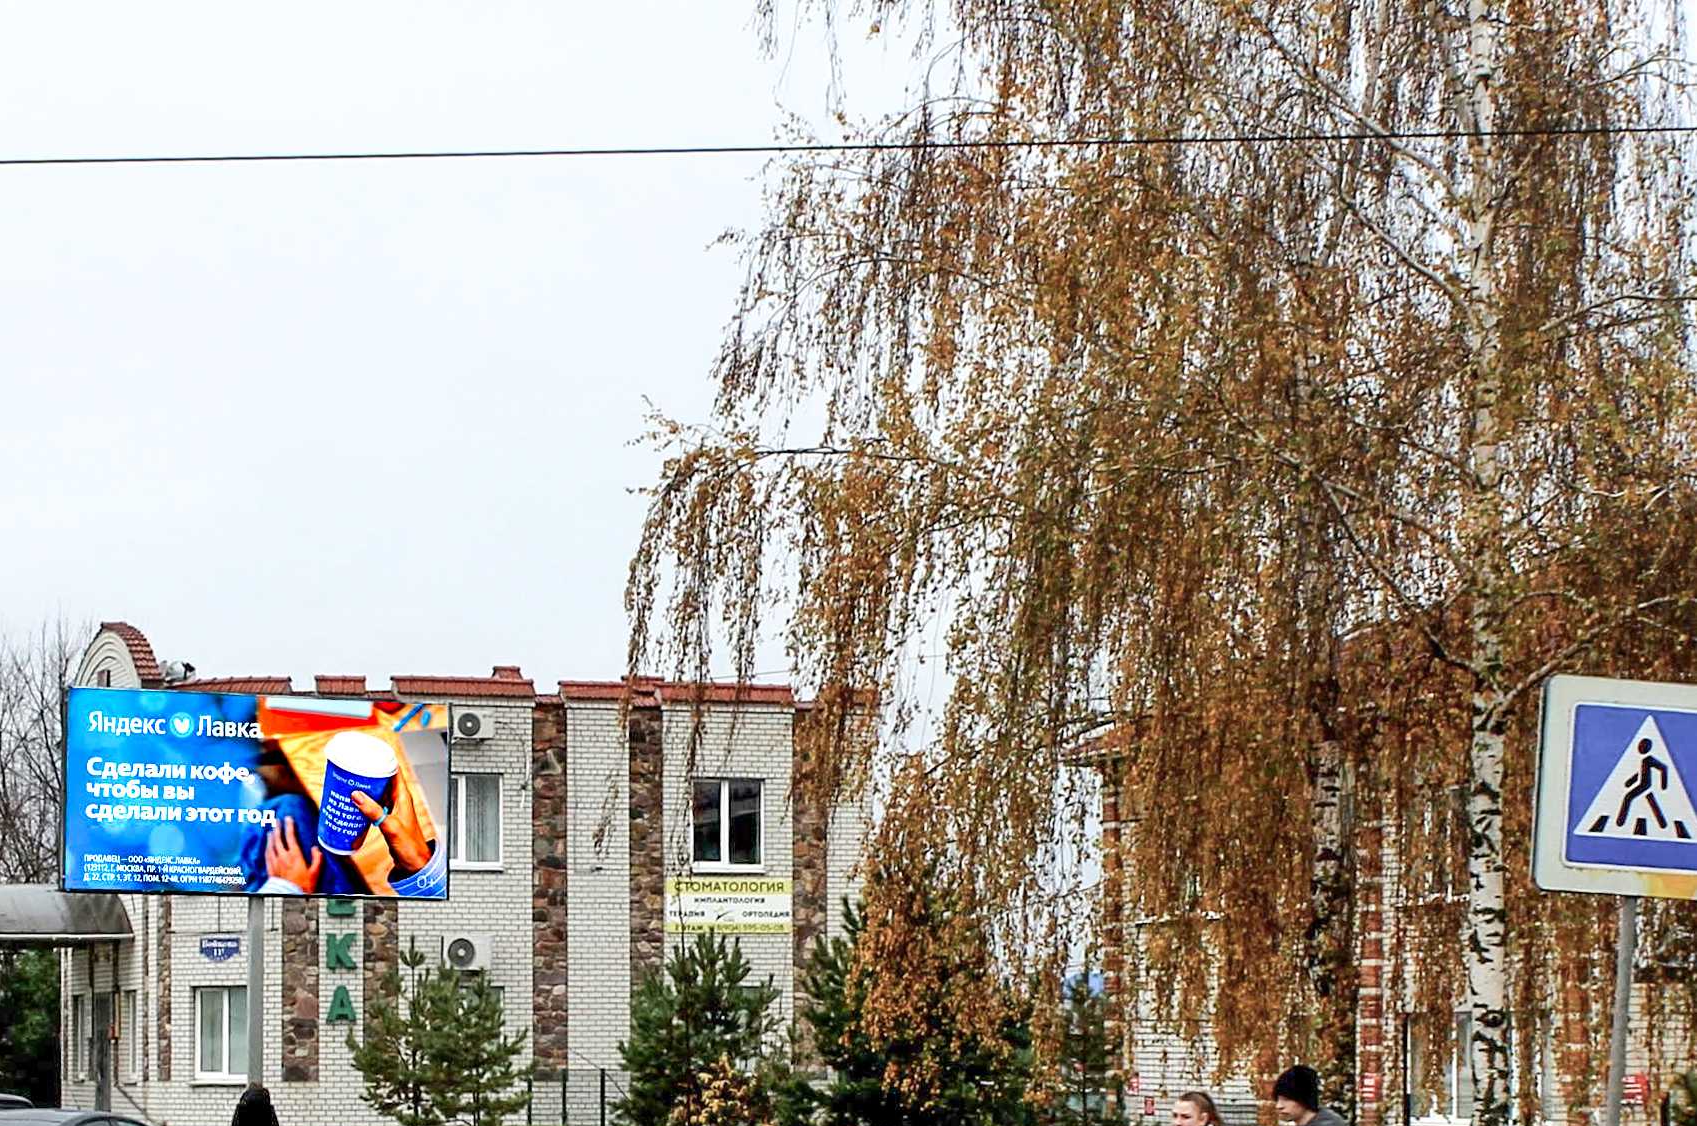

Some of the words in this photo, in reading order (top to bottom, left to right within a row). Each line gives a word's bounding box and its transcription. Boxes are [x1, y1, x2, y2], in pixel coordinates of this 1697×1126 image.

[88, 711, 166, 736] Яндекс
[197, 715, 263, 739] Лавка
[86, 757, 186, 780] Сделали
[191, 762, 255, 784] кофе,
[86, 779, 158, 799] чтобы
[163, 786, 195, 800] вы
[330, 790, 351, 804] напи
[85, 803, 182, 822] сделали
[186, 807, 235, 822] этот
[238, 810, 277, 827] год
[84, 855, 120, 864] ПРОДАВЕЦ
[128, 856, 143, 864] ООО
[116, 864, 146, 874] МОСКВА,
[147, 865, 157, 873] ПР.
[417, 876, 434, 888] 0+
[674, 881, 784, 893] СТОМАТОЛОГИЯ
[742, 910, 790, 919] ОРТОПЕДИЯ
